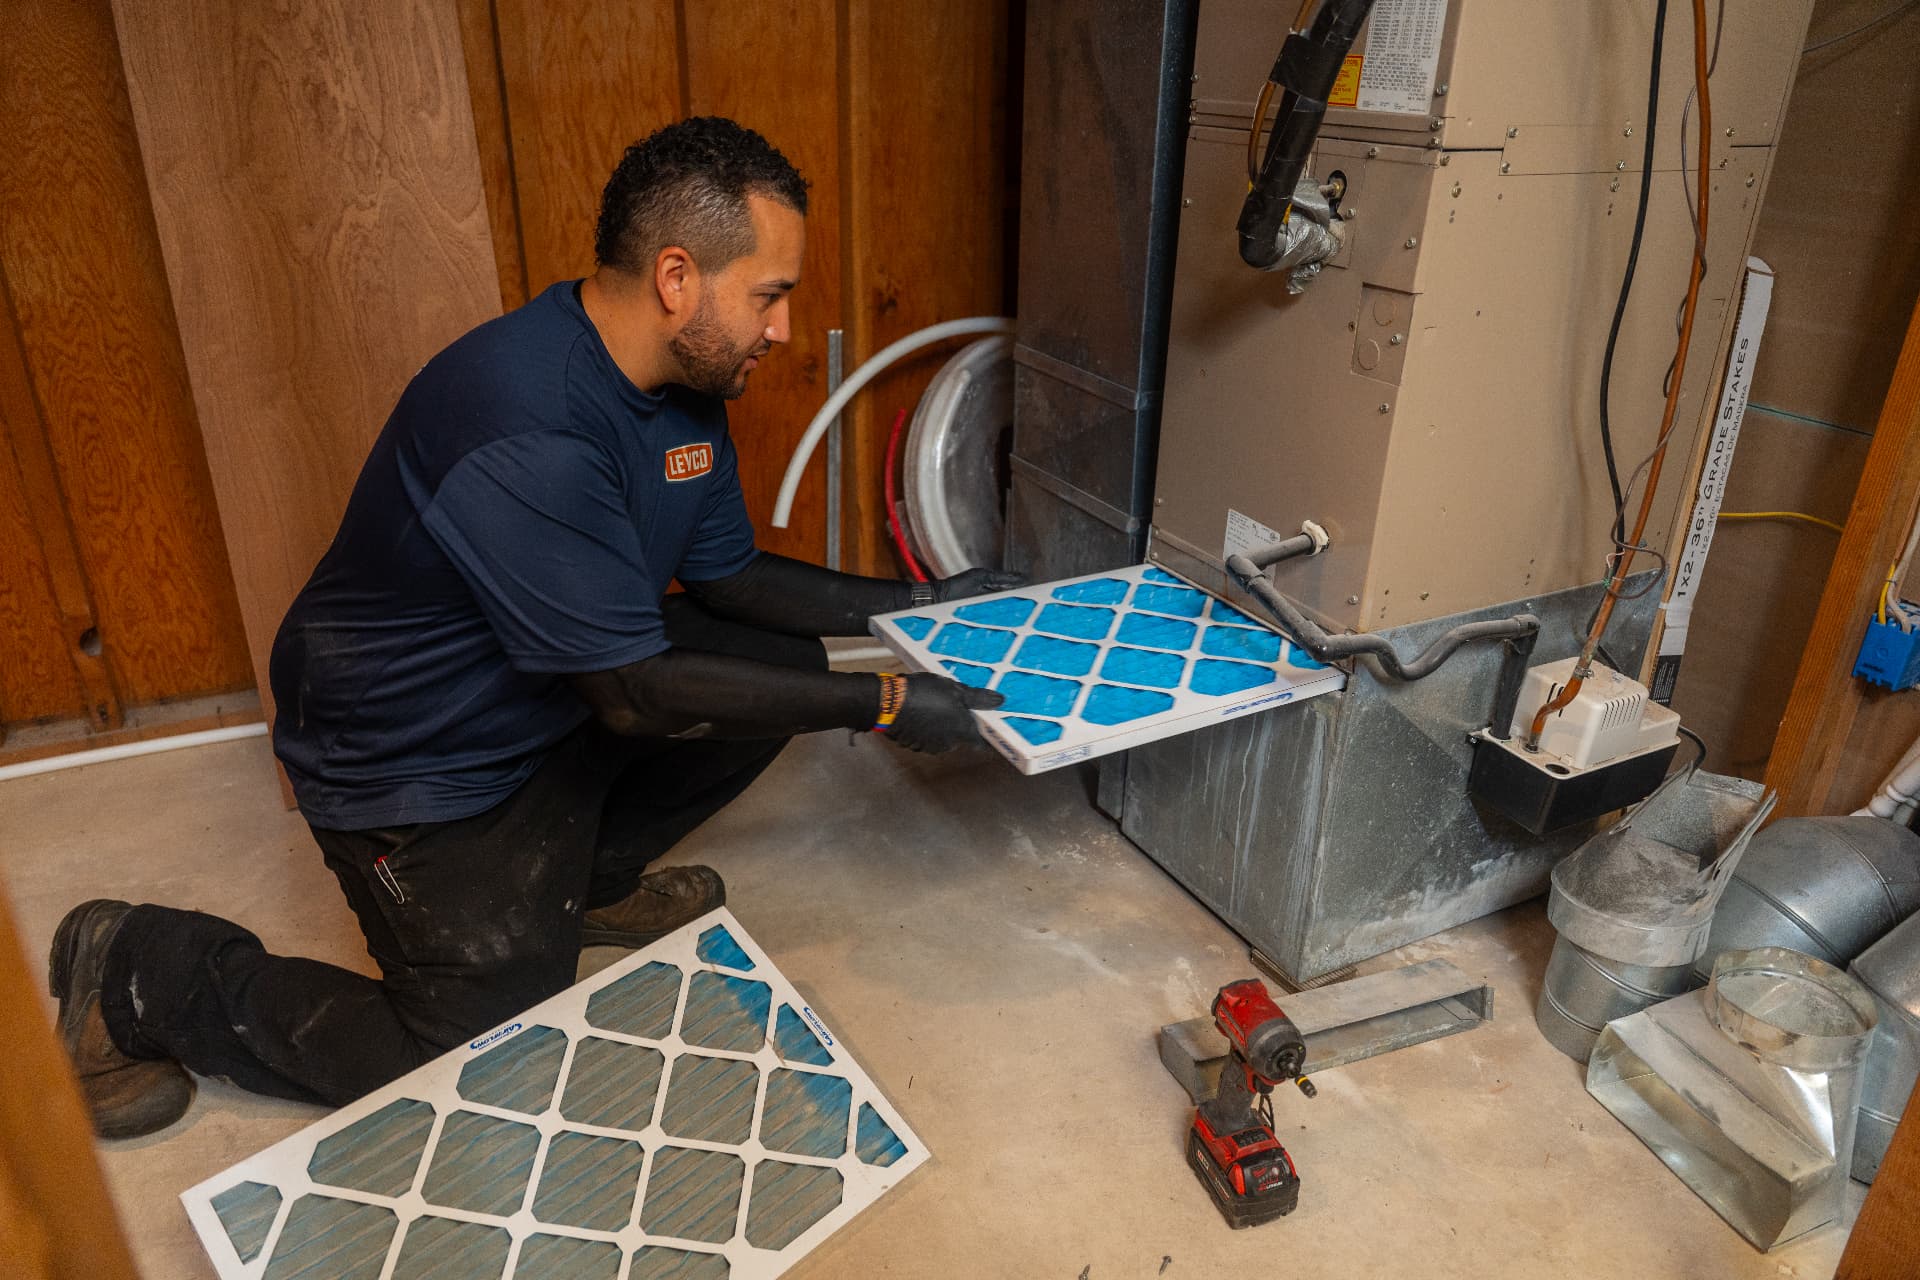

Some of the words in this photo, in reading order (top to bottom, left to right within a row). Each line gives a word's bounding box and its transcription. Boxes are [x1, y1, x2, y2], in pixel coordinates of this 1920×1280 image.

[669, 448, 708, 476] LEYCO
[1703, 426, 1729, 500] GRADE
[1723, 337, 1749, 420] STAKES
